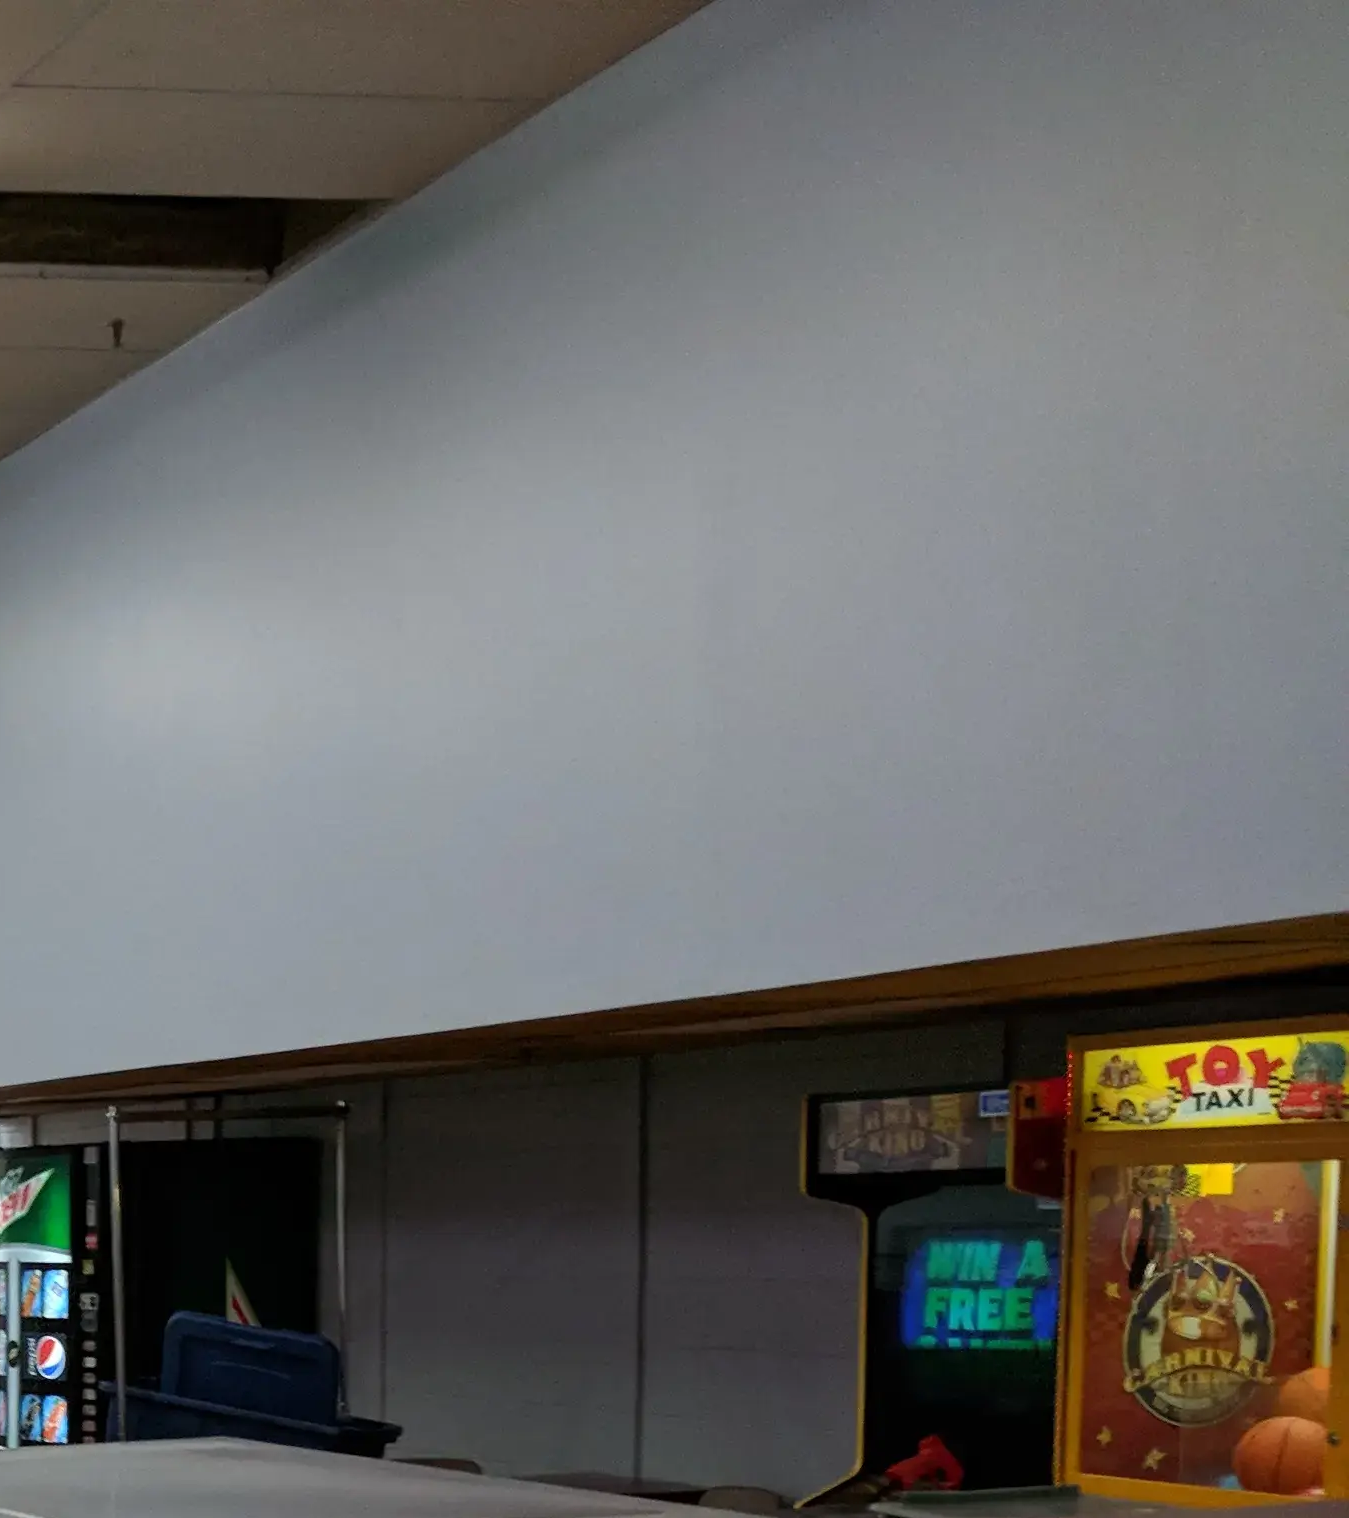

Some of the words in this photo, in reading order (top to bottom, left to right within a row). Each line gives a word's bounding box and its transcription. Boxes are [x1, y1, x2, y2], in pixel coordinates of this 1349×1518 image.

[1165, 1044, 1285, 1099] TOY
[1192, 1087, 1255, 1112] TAXI
[927, 1240, 1001, 1281] WIN
[1017, 1239, 1050, 1280] A
[925, 1286, 1034, 1331] FREE
